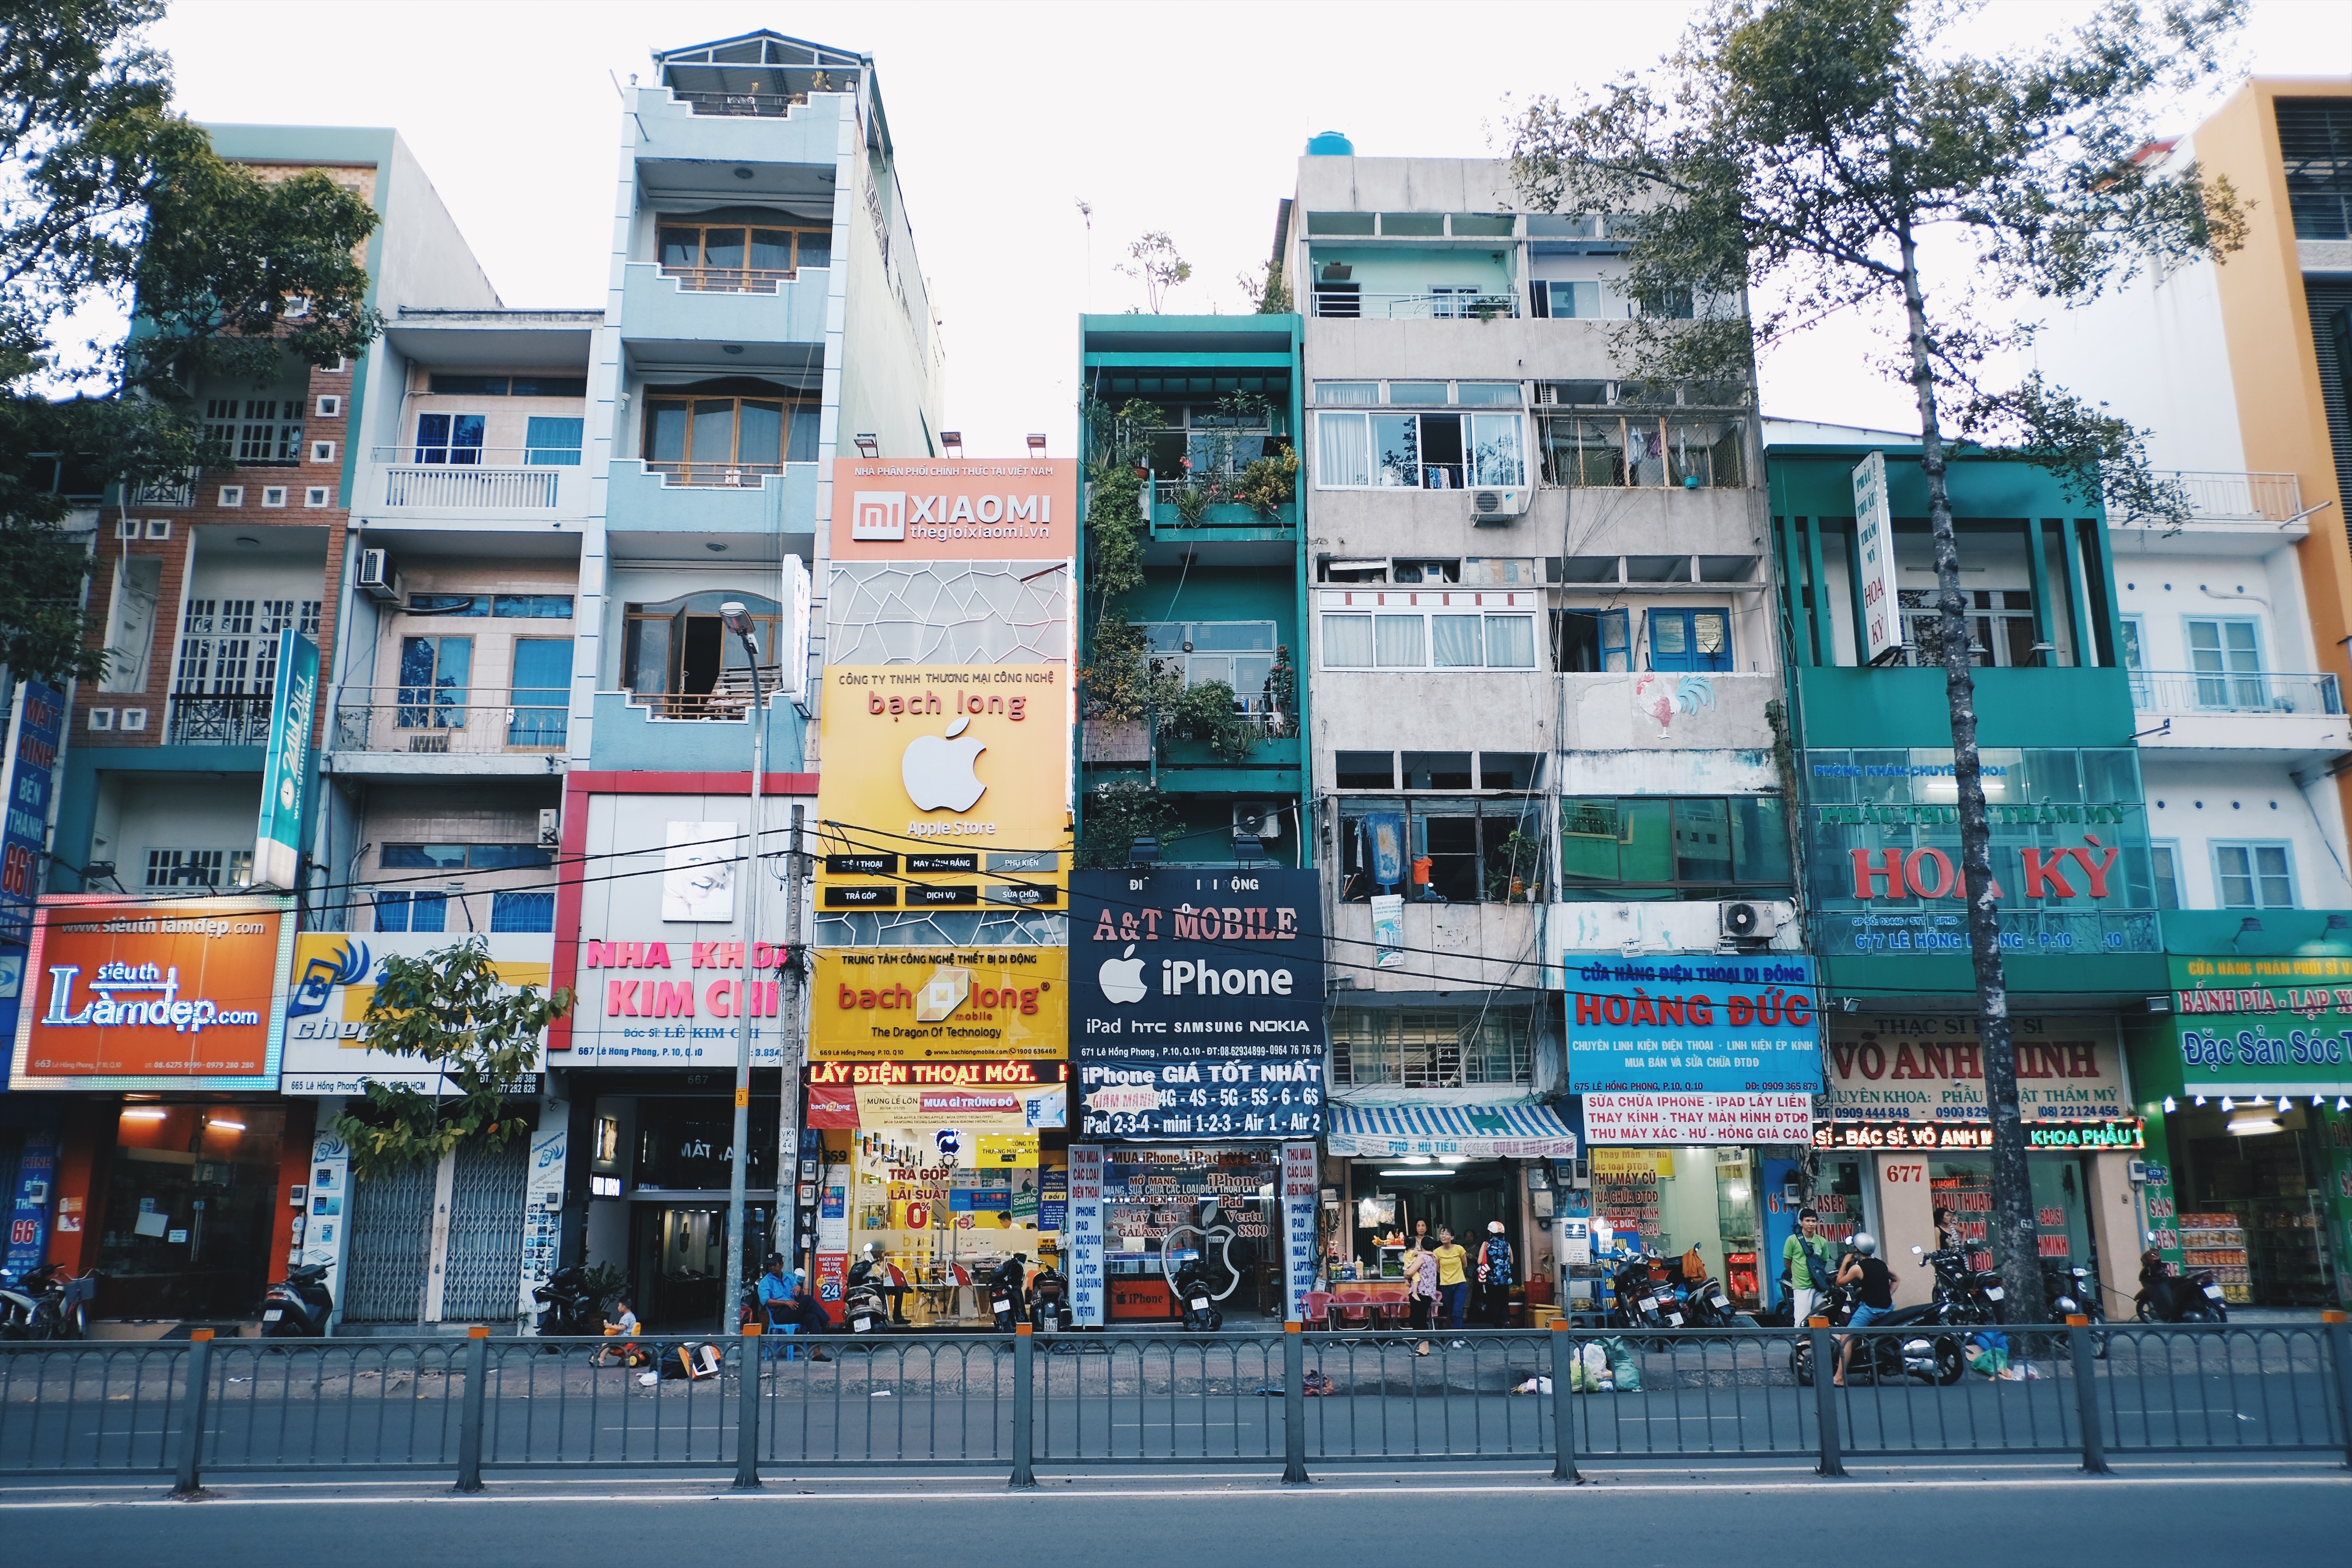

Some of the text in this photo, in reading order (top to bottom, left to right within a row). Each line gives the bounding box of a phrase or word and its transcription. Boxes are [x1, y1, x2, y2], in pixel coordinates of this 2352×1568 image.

[855, 464, 1053, 478] NHÀ PHÂN PHỐI CHÍNH THỨC TẠI VIỆT NAM
[909, 495, 1051, 524] XIAOMI
[911, 525, 1049, 541] thegioixiaomi.vn
[1864, 577, 1884, 608] HOA
[839, 671, 1054, 684] CÔNG TY TNHH THƯƠNG MẠI CÔNG NGHỆ
[869, 690, 1026, 722] bạch long
[19, 773, 41, 806] BẾN
[8, 807, 43, 842] THÀNH
[907, 821, 995, 838] Apple Store
[1, 841, 37, 899] 661
[1005, 858, 1038, 867] PHỤ KIỆN
[2019, 834, 2119, 898] KỲ
[845, 891, 877, 900] TRẢ GÓP
[926, 891, 956, 900] DỊCH VỤ
[1093, 907, 1298, 940] A&T MOBILE
[1856, 928, 1961, 949] 677 LÊ HỒNG
[586, 942, 788, 968] NHA KHOA
[1163, 959, 1293, 995] iPhone
[607, 980, 694, 1017] KIM
[838, 982, 1039, 1014] bach long
[1576, 986, 1811, 1026] HOÀNG ĐỨC
[955, 1012, 992, 1020] mobile
[872, 1027, 1001, 1039] The Dragon Of Technology
[1087, 1018, 1310, 1034] iPad SAMSUNG NOKIA
[632, 1048, 659, 1057] Phong,
[1082, 1046, 1129, 1058] 671 Lê Hồng
[2182, 1025, 2342, 1072] Đặc Sản Sóc
[1625, 1054, 1759, 1068] MUA BÁN VÀ SỬA CHỮA ĐTDĐ
[1892, 1041, 1982, 1079] ANH
[810, 1061, 850, 1083] LẤY
[853, 1062, 907, 1084] ĐIỆN
[912, 1065, 980, 1085] THOẠI
[1083, 1059, 1321, 1084] iPhone GIÁ TỐT NHẤT
[291, 1082, 425, 1093] 665 Lê Hồng HCM
[688, 1076, 709, 1084] 667
[867, 1095, 887, 1105] MỪNG
[923, 1098, 947, 1107] MUA
[949, 1097, 960, 1107] GÌ
[963, 1098, 996, 1107] TRÚNG
[998, 1097, 1013, 1107] ĐÓ
[1083, 1114, 1264, 1134] iPad 2-3-4 mini 1-2-3 Air
[1589, 1111, 1770, 1123] THAY KÍNH THAY MÀN HÌNH
[2031, 1129, 2079, 1145] KHOA
[1074, 1150, 1098, 1164] THU MUA
[888, 1167, 950, 1180] TRẢ GÓP
[1149, 1176, 1177, 1185] MANG
[1208, 1173, 1262, 1187] iPhone
[1616, 1169, 1656, 1185] MÁY CŨ
[1887, 1165, 1922, 1183] 677
[915, 1184, 949, 1199] SUẤT
[1013, 1195, 1037, 1206] Selfie
[1218, 1195, 1244, 1208] iPad
[1076, 1206, 1096, 1216] IPHONE
[1225, 1210, 1264, 1222] Vertu
[1238, 1225, 1268, 1237] 8800
[2020, 1219, 2033, 1228] 62
[821, 1284, 840, 1299] 24
[1129, 1293, 1163, 1304] iPhone
